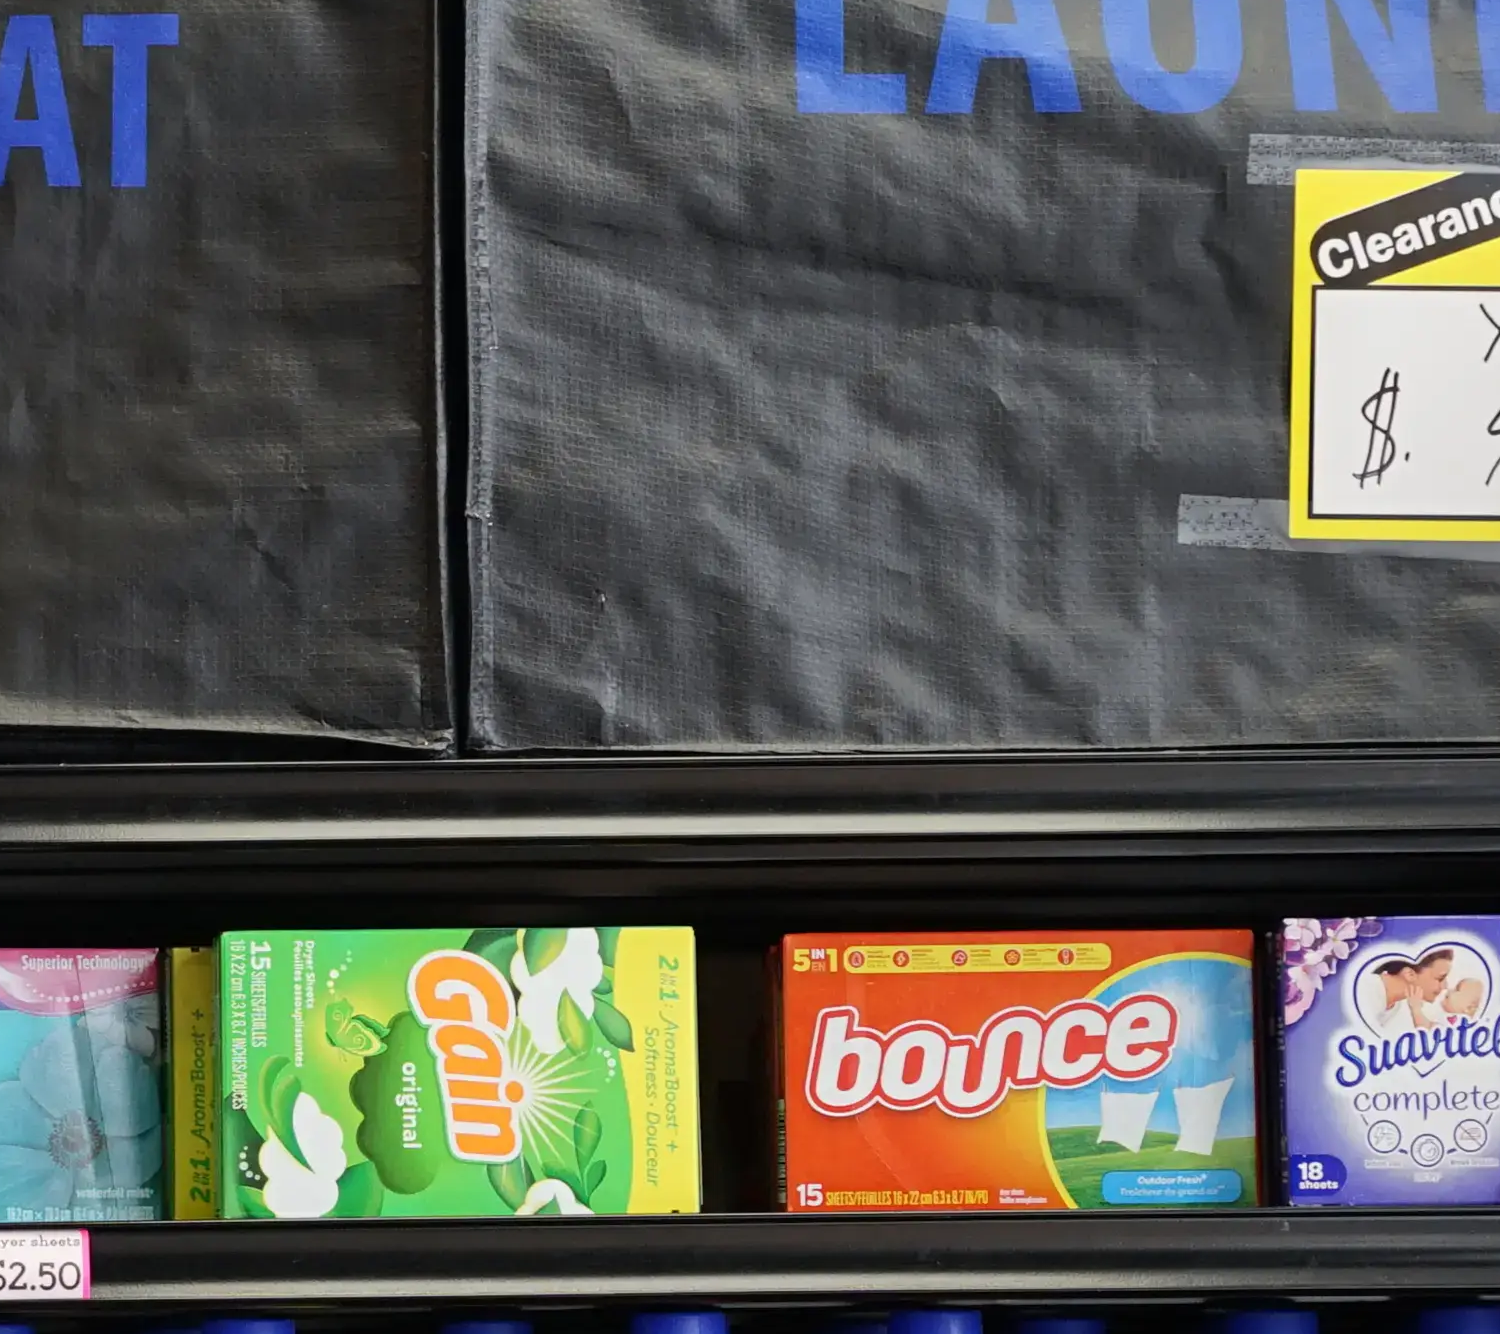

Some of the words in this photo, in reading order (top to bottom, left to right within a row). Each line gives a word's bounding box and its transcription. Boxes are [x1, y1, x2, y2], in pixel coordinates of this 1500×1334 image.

[410, 952, 520, 1160] Gain
[643, 1025, 661, 1099] Softness
[808, 995, 1178, 1116] bounce
[395, 1062, 424, 1149] original
[1353, 1079, 1500, 1120] complete
[643, 1111, 662, 1187] Douceur
[1298, 1161, 1323, 1180] 18
[796, 1183, 823, 1207] 15
[1299, 1178, 1339, 1190] sheets
[30, 1236, 81, 1249] sheets
